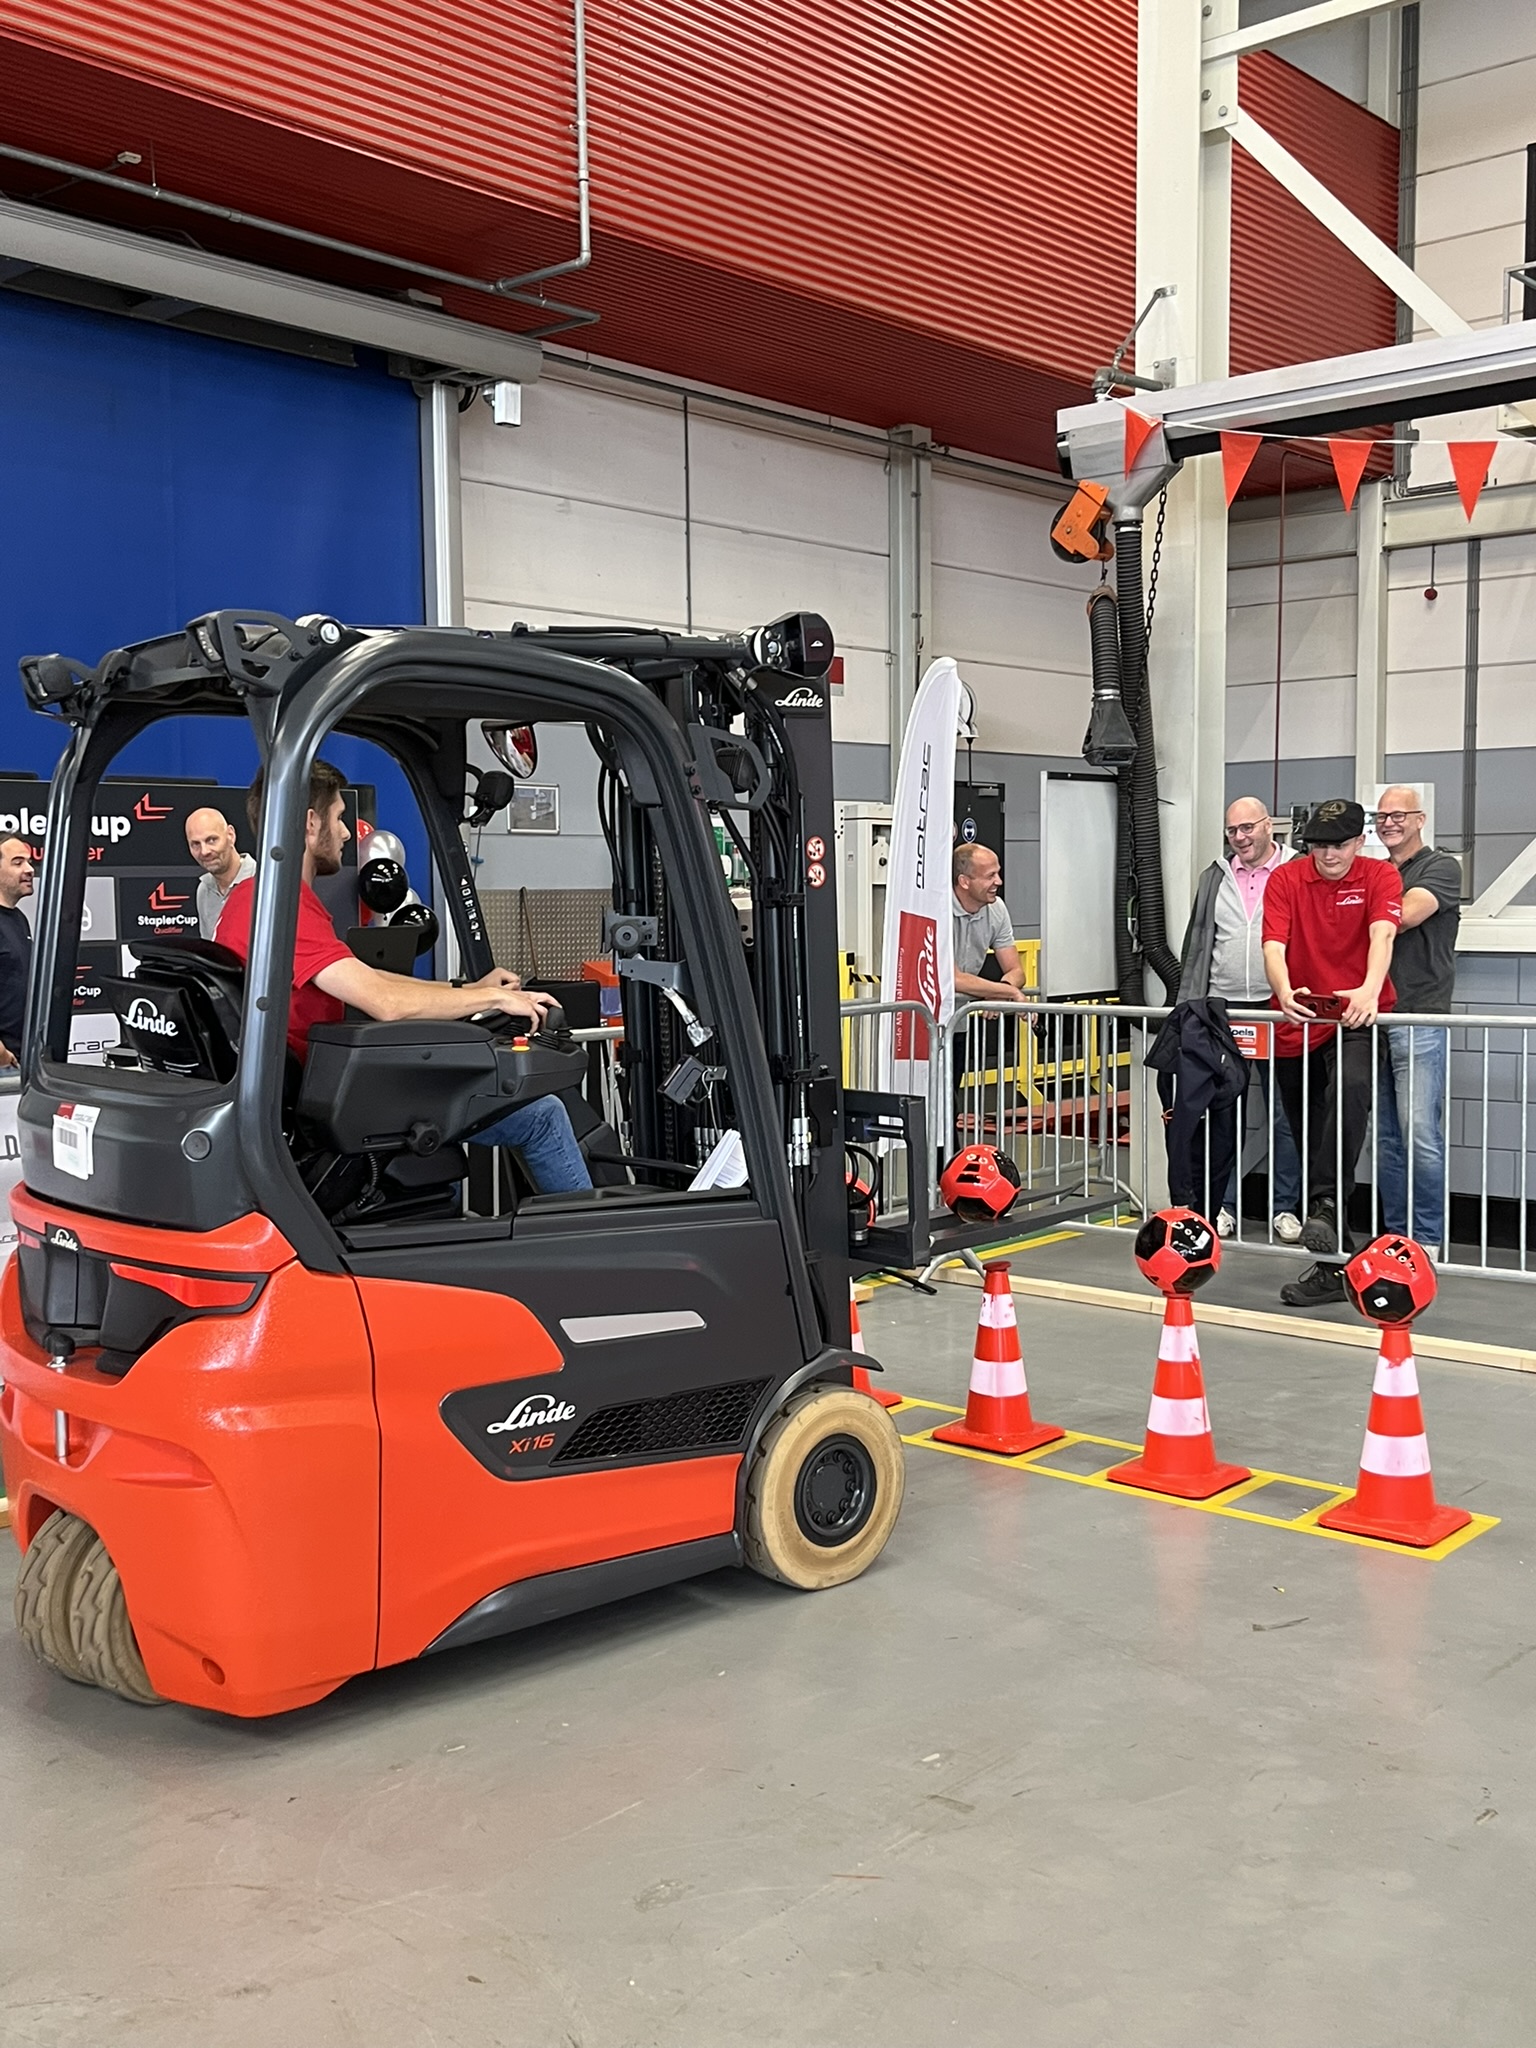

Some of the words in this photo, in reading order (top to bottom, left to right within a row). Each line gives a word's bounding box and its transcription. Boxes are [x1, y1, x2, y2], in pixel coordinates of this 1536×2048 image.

[774, 687, 824, 707] Linde
[916, 742, 930, 889] motrac
[137, 914, 198, 927] StaplerCup
[918, 926, 937, 1016] Linde
[121, 998, 179, 1037] Linde
[1230, 1027, 1254, 1036] oels
[70, 1040, 115, 1052] rac
[50, 1228, 79, 1251] Linde
[486, 1394, 576, 1434] Linde
[509, 1433, 556, 1454] Xi16
